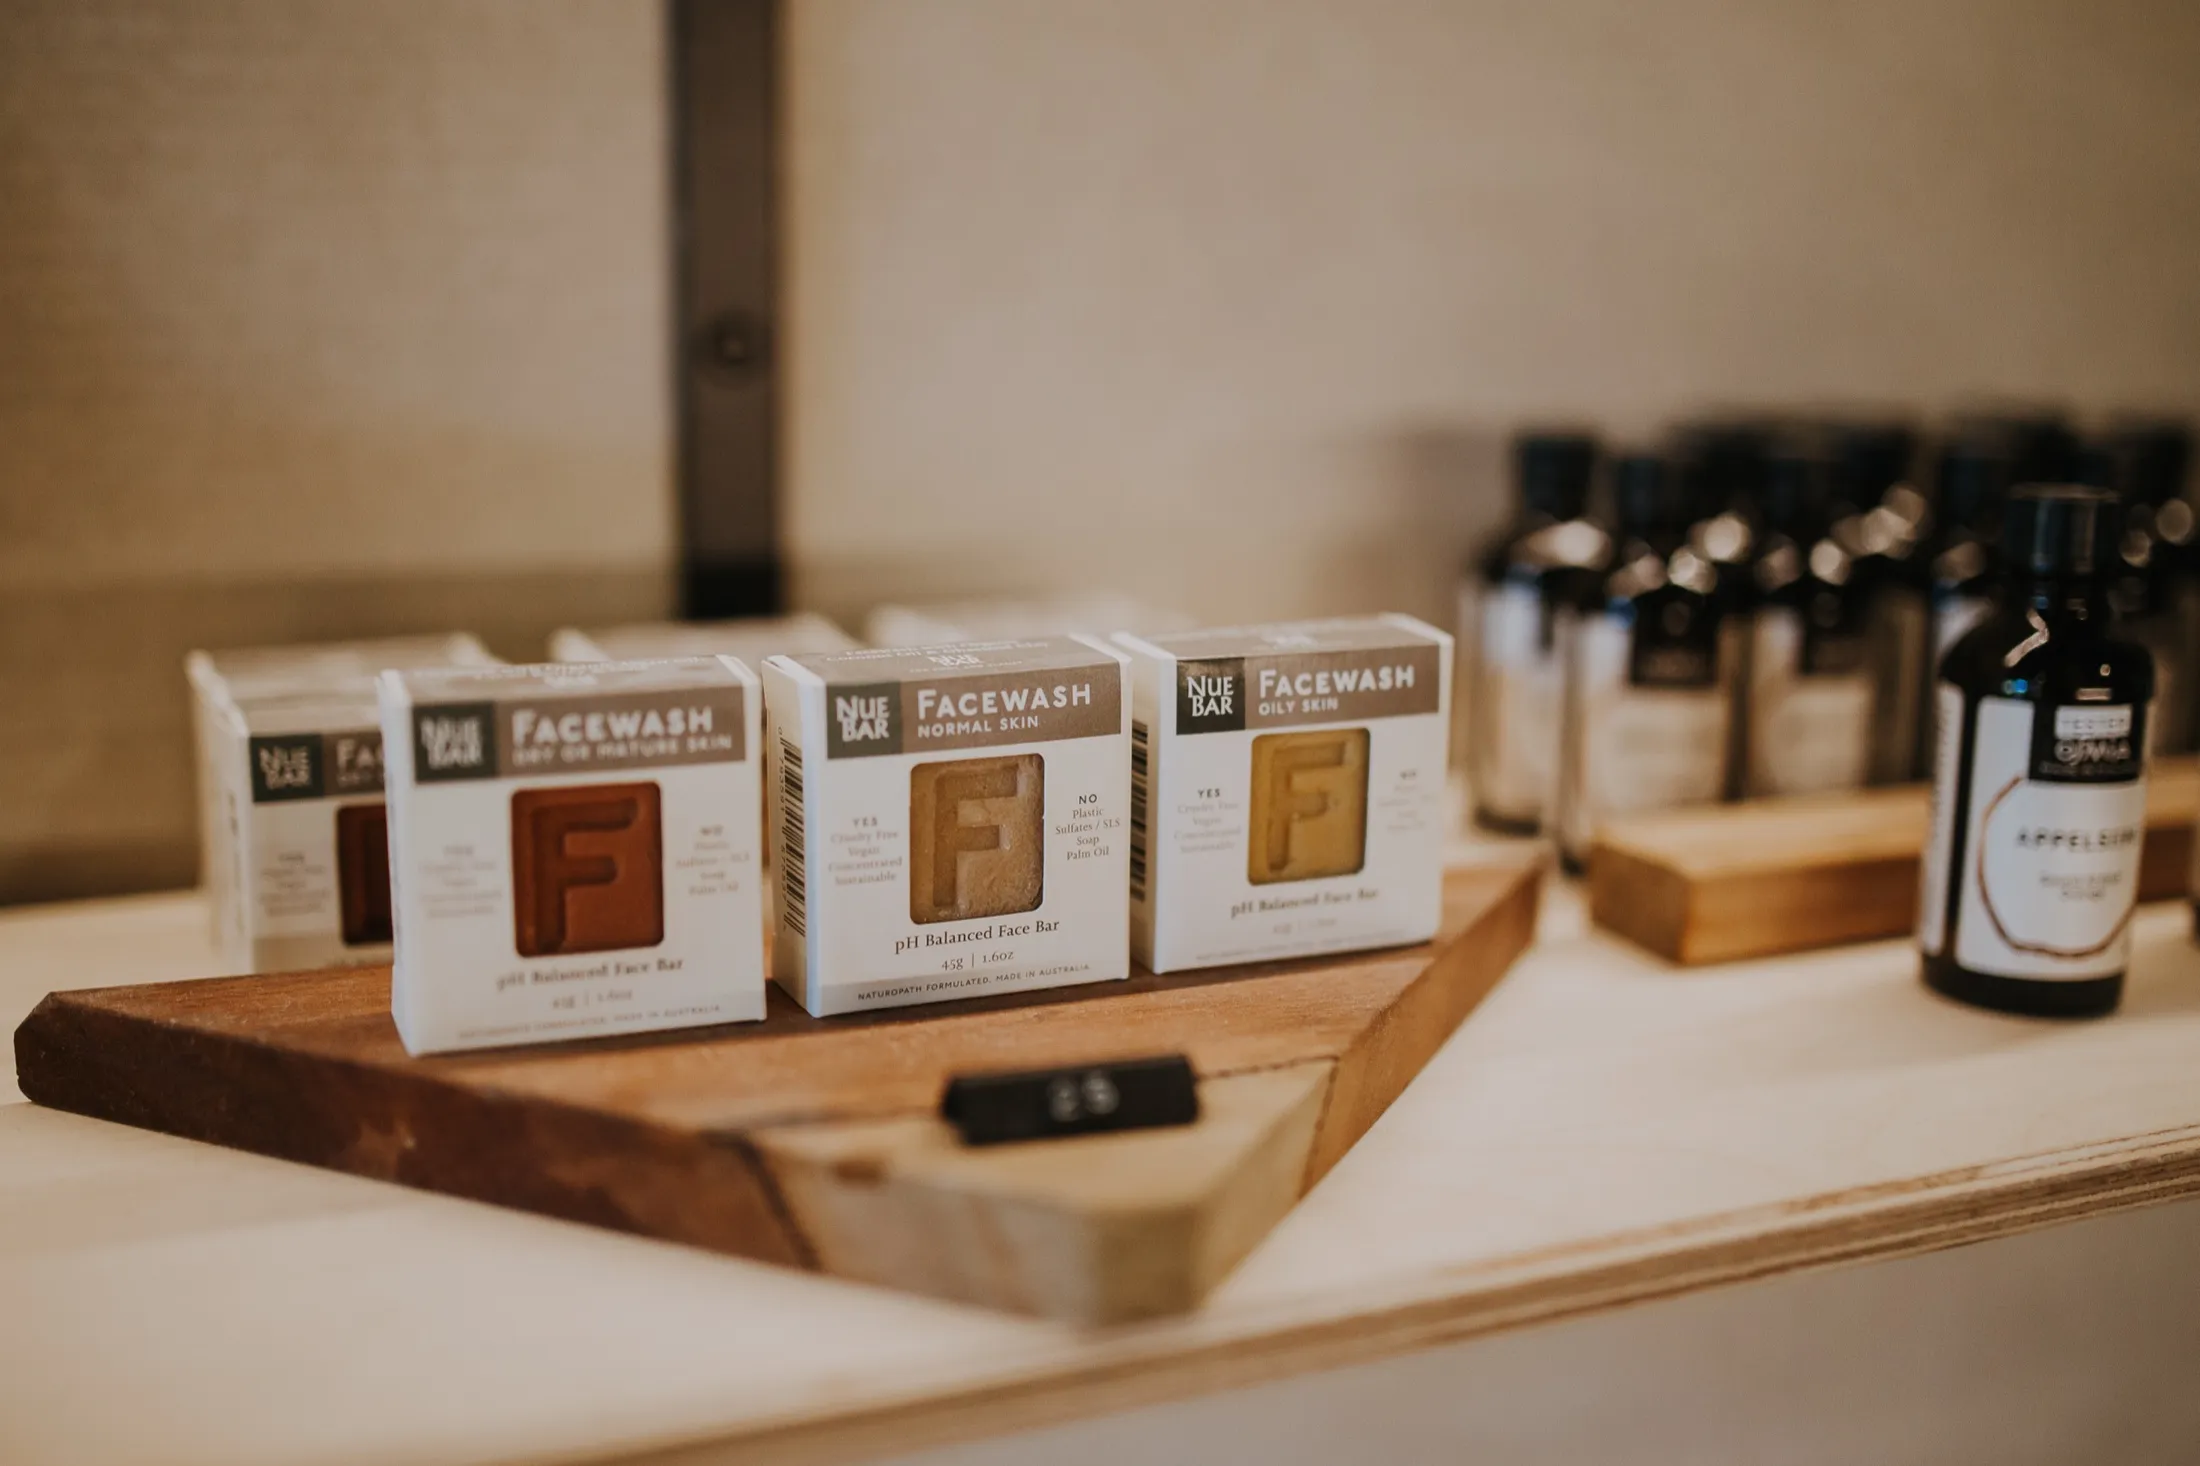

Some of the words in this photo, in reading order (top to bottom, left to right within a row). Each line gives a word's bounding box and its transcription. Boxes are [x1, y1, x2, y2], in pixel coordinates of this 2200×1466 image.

[1186, 674, 1234, 698] NUE
[1259, 664, 1415, 699] FACEWASH
[835, 694, 890, 722] NUE
[917, 683, 1092, 720] FACEWASH
[1191, 695, 1234, 717] BAR
[1257, 700, 1294, 716] OILY
[1302, 697, 1339, 713] SKIN
[421, 716, 482, 748] NUE
[512, 706, 713, 746] FACEWASH
[842, 717, 890, 742] BAR
[917, 722, 992, 738] NORMAL
[999, 715, 1039, 731] SKIN
[427, 741, 484, 770] BAR
[512, 746, 554, 767] DRY
[561, 743, 591, 763] OR
[597, 737, 679, 760] MATURE
[686, 734, 732, 753] SKIN
[1078, 793, 1098, 805] NO
[1197, 788, 1220, 799] YES
[852, 816, 878, 828] YES
[1072, 806, 1104, 819] Plastic
[1055, 822, 1093, 835] Sulfates
[1103, 817, 1121, 829] SLS
[1066, 849, 1091, 861] Palm
[1093, 845, 1110, 857] Oil
[1076, 836, 1100, 847] Soap
[1231, 901, 1254, 919] pH
[1259, 893, 1319, 913] Balanced
[895, 934, 919, 954] pH
[926, 926, 993, 947] Balanced
[999, 924, 1031, 938] Face
[1036, 919, 1060, 933] Bar
[531, 964, 609, 985] Balanced
[614, 960, 649, 977] Face
[656, 958, 684, 972] Bar
[942, 957, 964, 971] 45g
[982, 951, 1014, 964] 1.6oz
[857, 985, 922, 1000] NATUROPATH
[926, 977, 992, 991] FORMULATED.
[996, 971, 1022, 982] MADE
[1025, 970, 1036, 979] IN
[1039, 964, 1090, 977] AUSTRALIA
